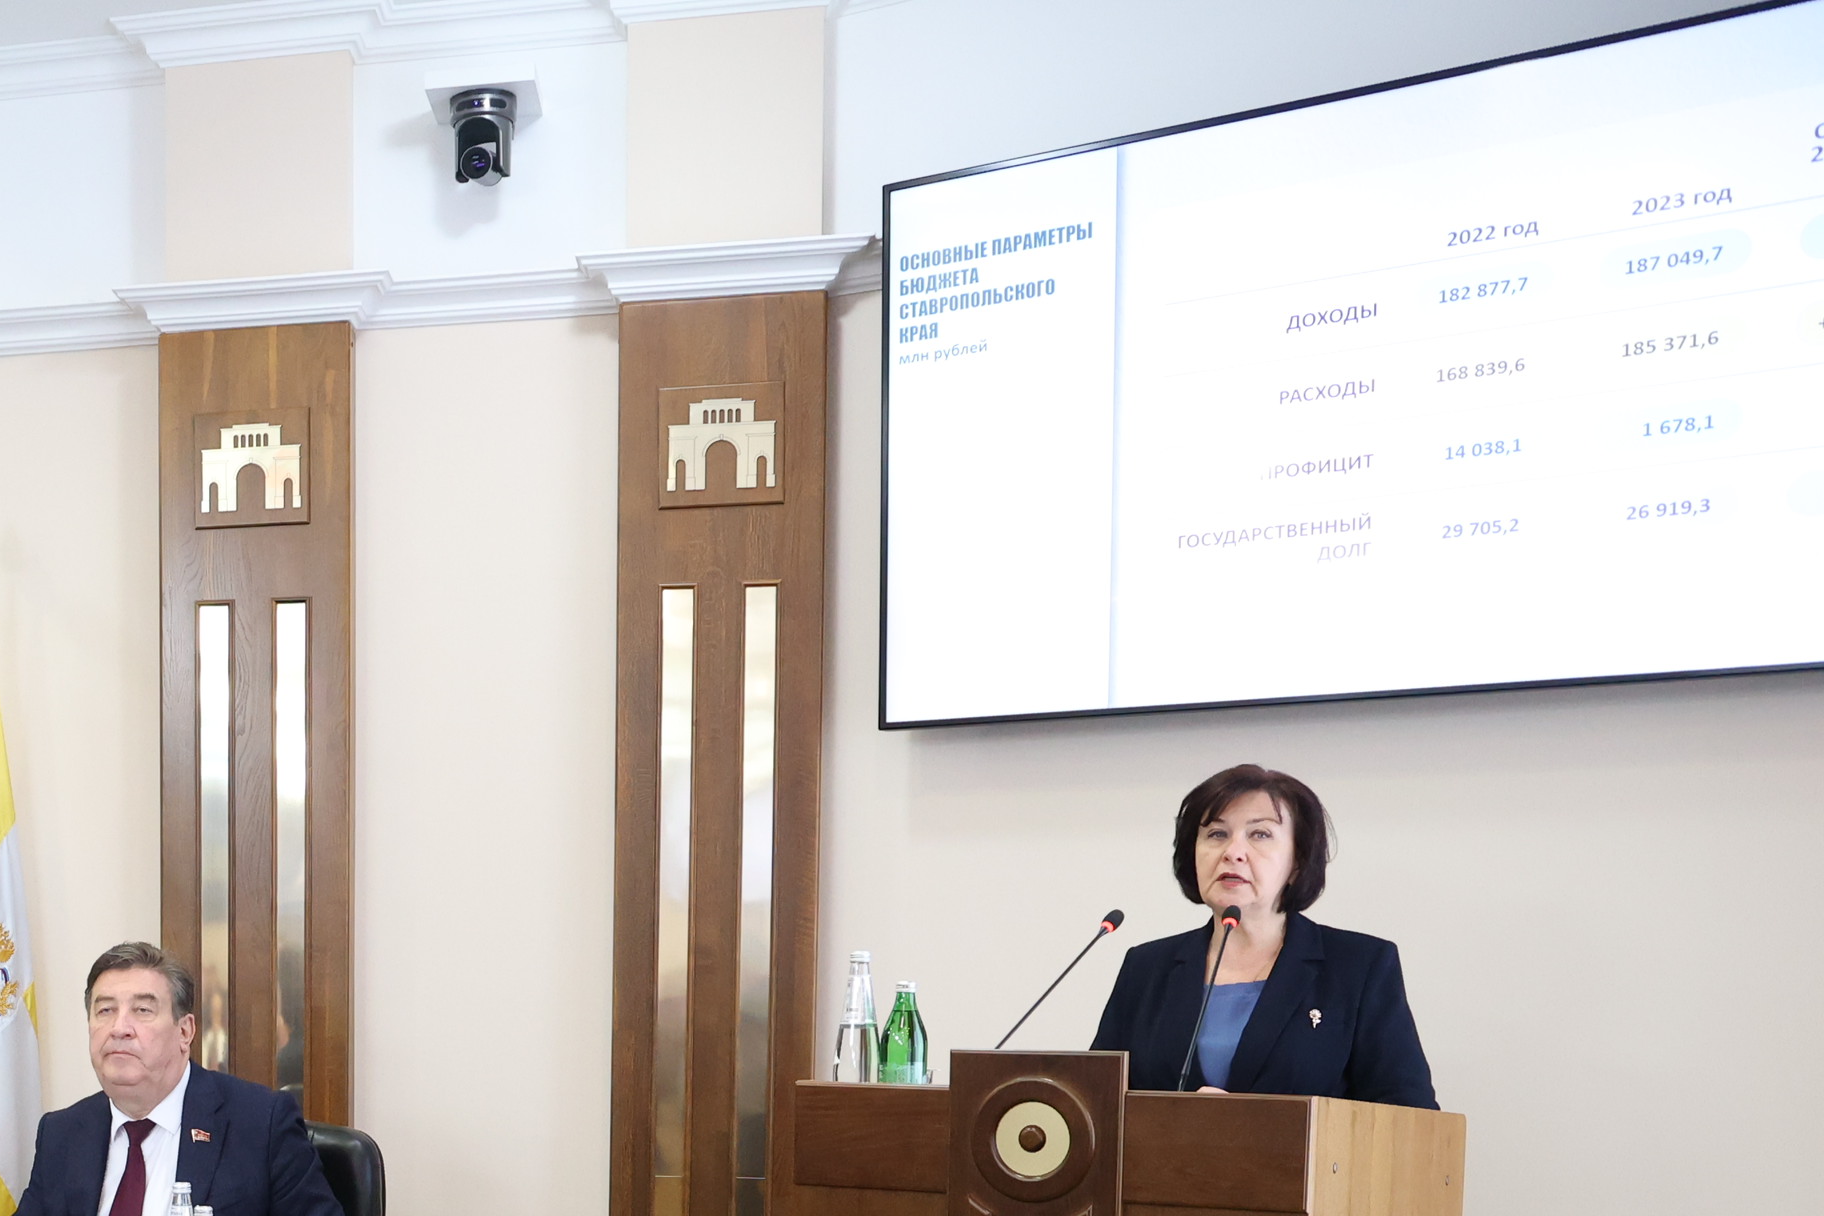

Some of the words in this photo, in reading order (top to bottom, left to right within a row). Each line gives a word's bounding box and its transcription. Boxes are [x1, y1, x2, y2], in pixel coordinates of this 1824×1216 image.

[1632, 193, 1685, 216] 2023
[1694, 187, 1733, 206] год
[899, 241, 988, 272] ОСНОВНЫЕ
[991, 221, 1093, 256] ПАРАМЕТРЫ
[1447, 225, 1496, 247] 2022
[1504, 221, 1539, 238] год
[1625, 256, 1661, 275] 187
[1667, 246, 1724, 268] 049,7
[899, 267, 980, 296] БЮДЖЕТА
[1439, 286, 1471, 304] 182
[1477, 277, 1528, 298] 877,7
[899, 278, 1056, 320] СТАВРОПОЛЬСКОГО
[1286, 303, 1377, 334] ДОХОДЫ
[899, 322, 939, 344] КРАЯ
[1622, 339, 1657, 358] 185
[1663, 331, 1720, 352] 371,6
[898, 352, 930, 365] млн
[934, 339, 988, 362] рублей
[1436, 366, 1468, 383] 168
[1474, 358, 1526, 378] 839,6
[1279, 379, 1375, 405] РАСХОДЫ
[1642, 422, 1652, 437] 1
[1660, 415, 1714, 435] 678,1
[1445, 445, 1466, 461] 14
[1471, 438, 1522, 457] 038,1
[1626, 504, 1650, 520] 26
[1656, 498, 1711, 517] 919,3
[1178, 512, 1372, 549] ГОСУДАРСТВЕННЫЙ
[1442, 524, 1463, 539] 29
[1470, 518, 1520, 537] 705,2
[1317, 542, 1372, 564] ДОЛГ
